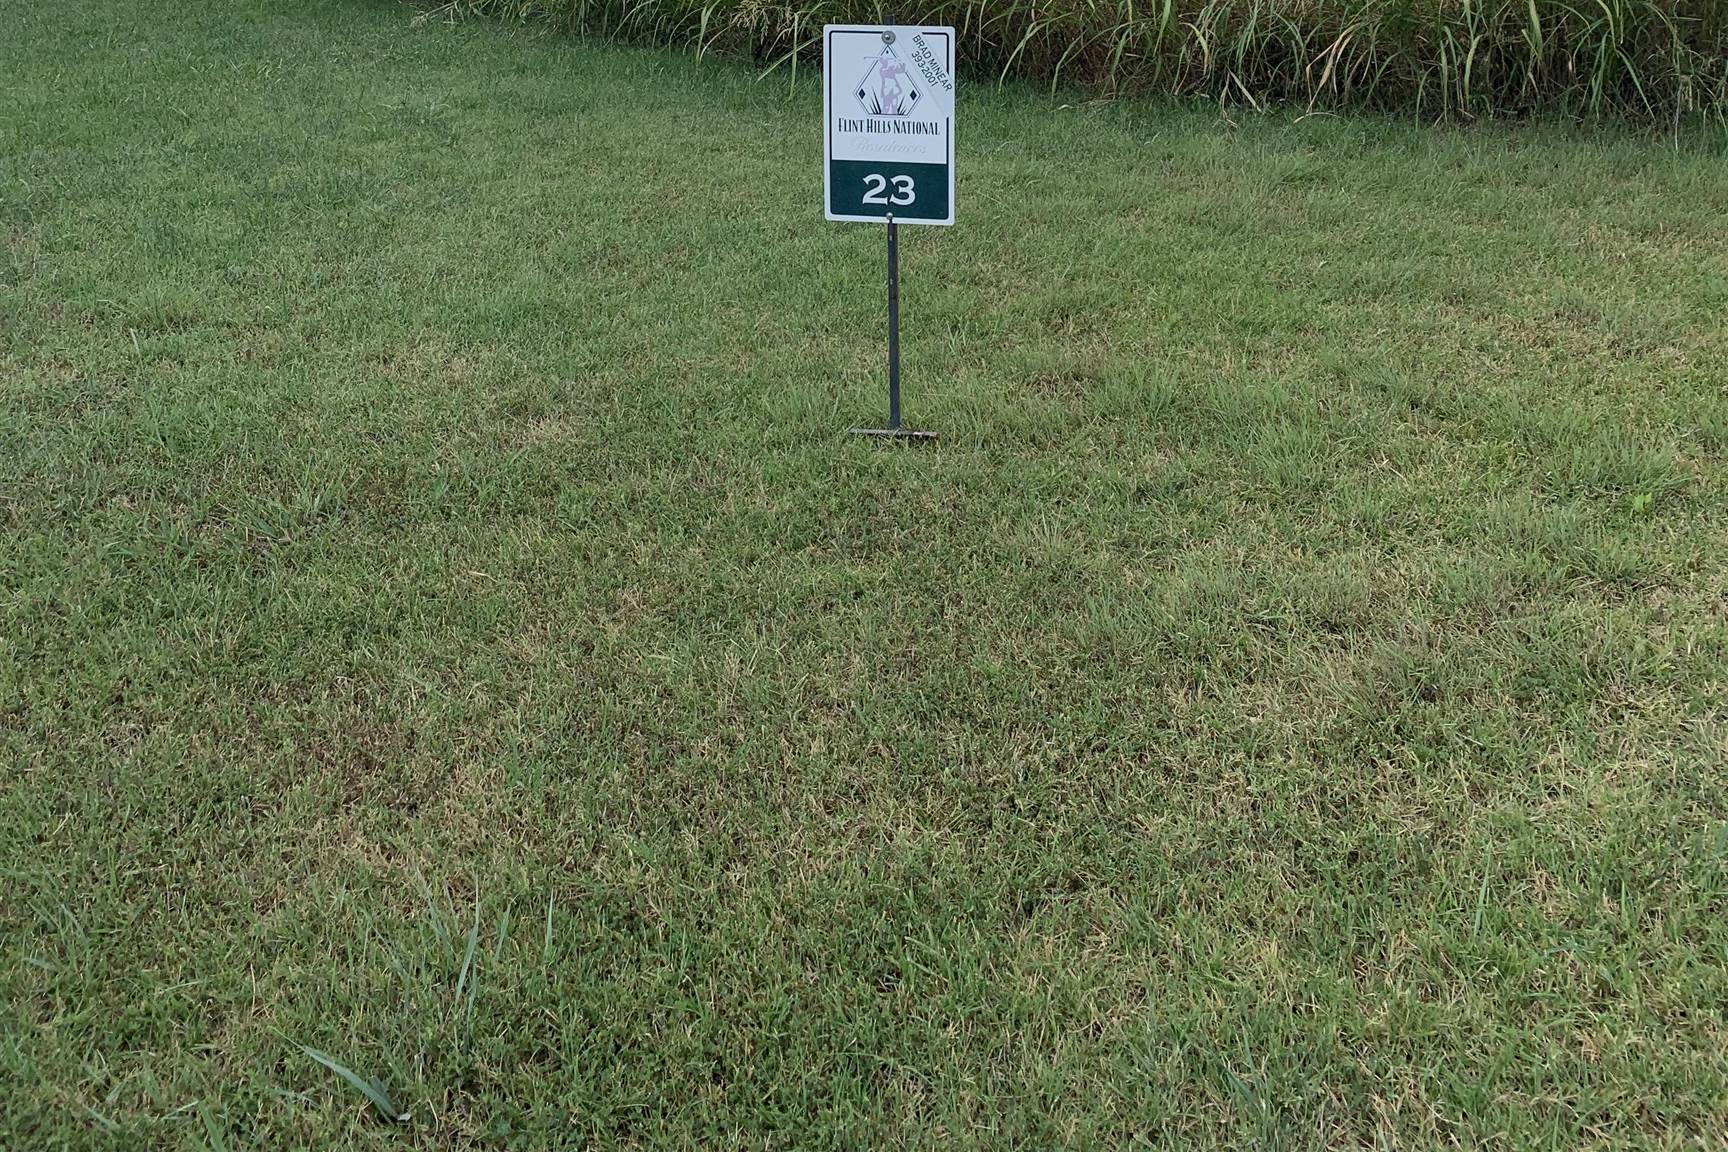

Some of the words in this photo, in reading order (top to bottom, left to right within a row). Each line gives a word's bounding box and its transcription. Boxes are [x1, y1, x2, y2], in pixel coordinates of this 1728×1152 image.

[911, 50, 938, 87] 393-2001
[912, 34, 932, 59] BRAD
[927, 58, 953, 92] MINEAR
[838, 117, 864, 133] FLINT
[866, 118, 891, 134] HILLS
[893, 119, 940, 136] NATIONAL
[862, 173, 916, 206] 23
